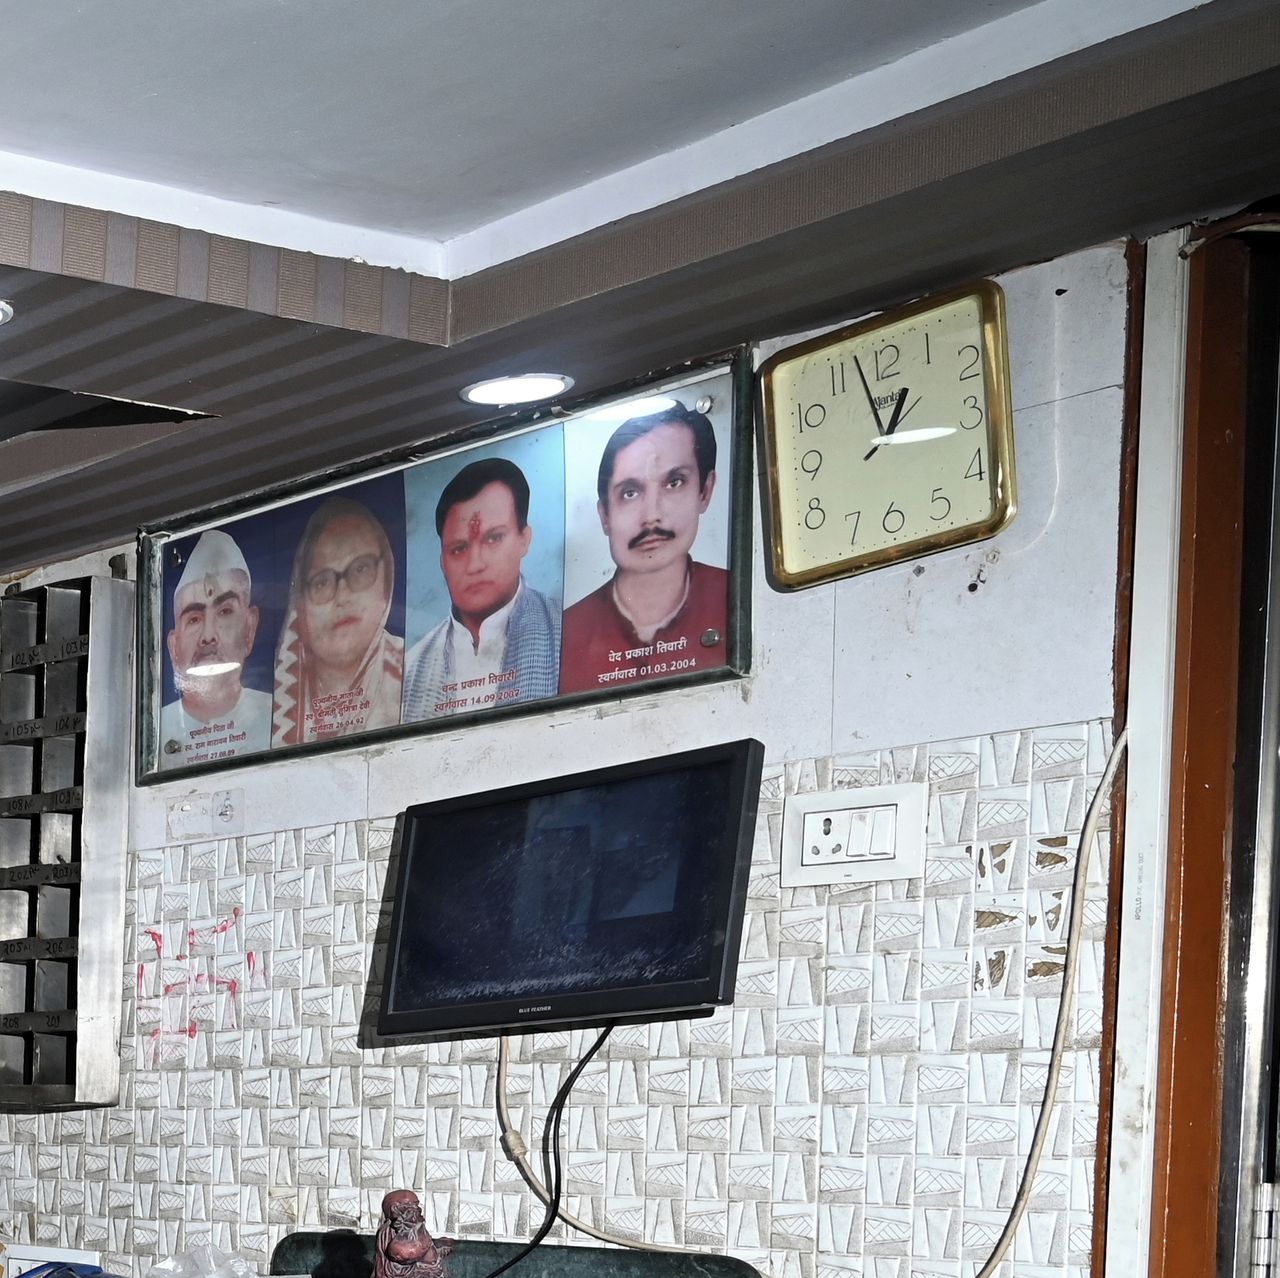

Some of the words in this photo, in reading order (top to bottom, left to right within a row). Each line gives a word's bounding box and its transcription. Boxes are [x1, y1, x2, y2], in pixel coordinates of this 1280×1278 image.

[875, 345, 901, 381] 12
[925, 333, 931, 364] 1
[958, 345, 980, 381] 2
[831, 362, 846, 396] 11
[798, 403, 826, 433] 10
[959, 395, 983, 430] 3
[801, 450, 823, 481] 9
[963, 447, 986, 481] 4
[805, 498, 825, 530] 8
[882, 501, 905, 533] 6
[929, 487, 951, 520] 5
[844, 511, 861, 545] 7
[608, 650, 623, 662] वेद
[624, 646, 654, 661] प्रकाश
[656, 636, 688, 654] तिवारी
[461, 677, 486, 690] प्रकाश
[598, 667, 637, 683] स्वर्गवास
[640, 658, 697, 676] 01.03.2004
[434, 698, 468, 712] स्वर्गवास
